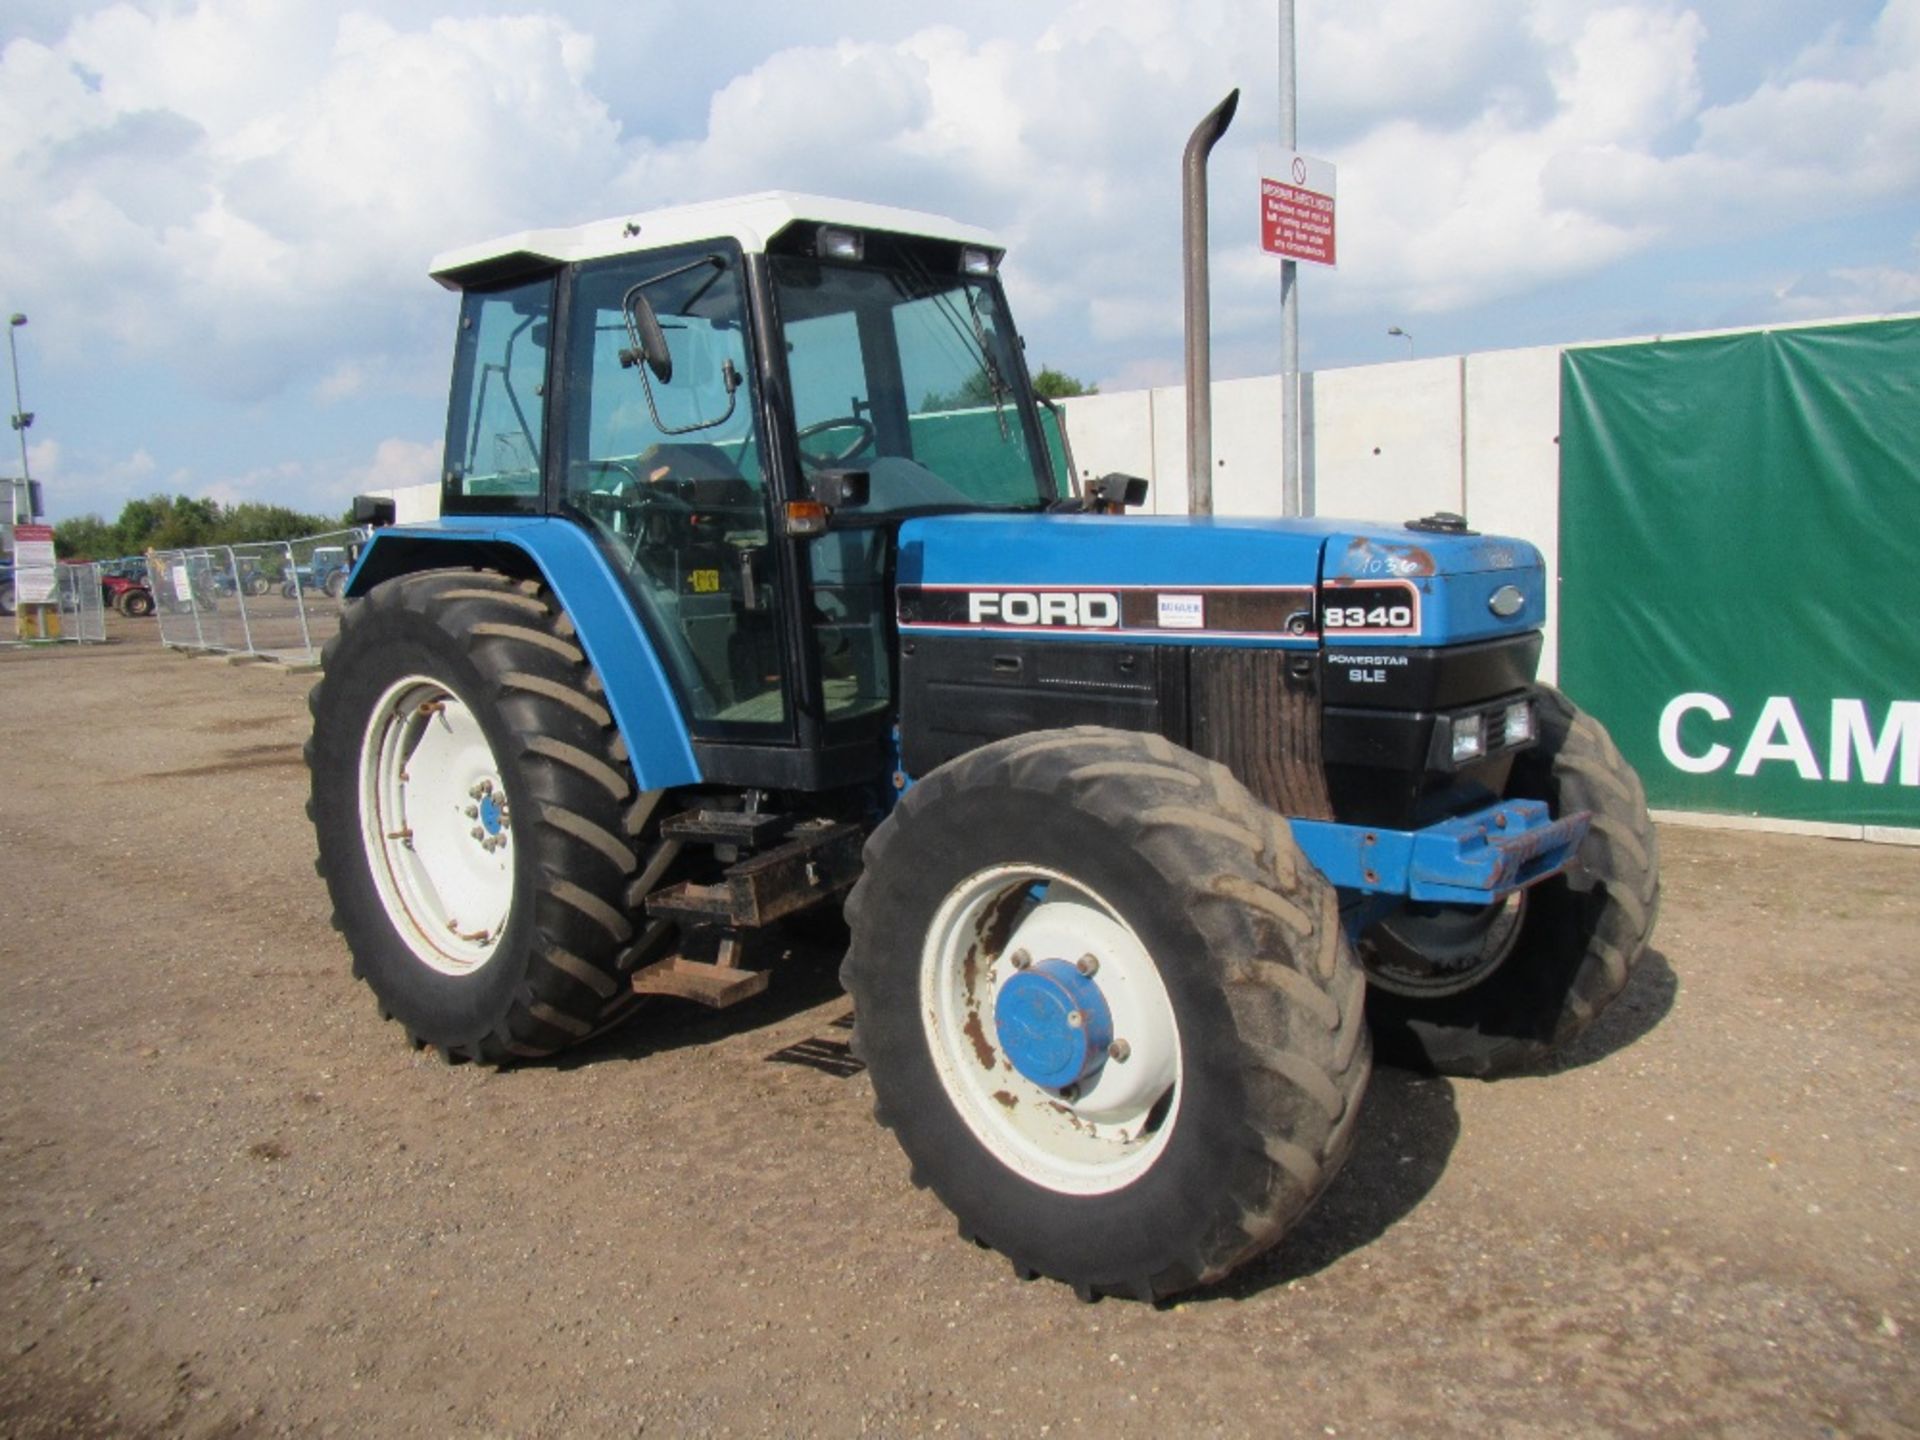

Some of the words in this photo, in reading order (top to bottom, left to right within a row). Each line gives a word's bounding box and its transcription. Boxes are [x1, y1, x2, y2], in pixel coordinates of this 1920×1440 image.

[969, 592, 1118, 626] FORD
[1325, 607, 1410, 627] 8340
[1328, 654, 1408, 666] POWERSTAR
[1349, 669, 1386, 682] SLE
[1658, 692, 1920, 786] CAM
